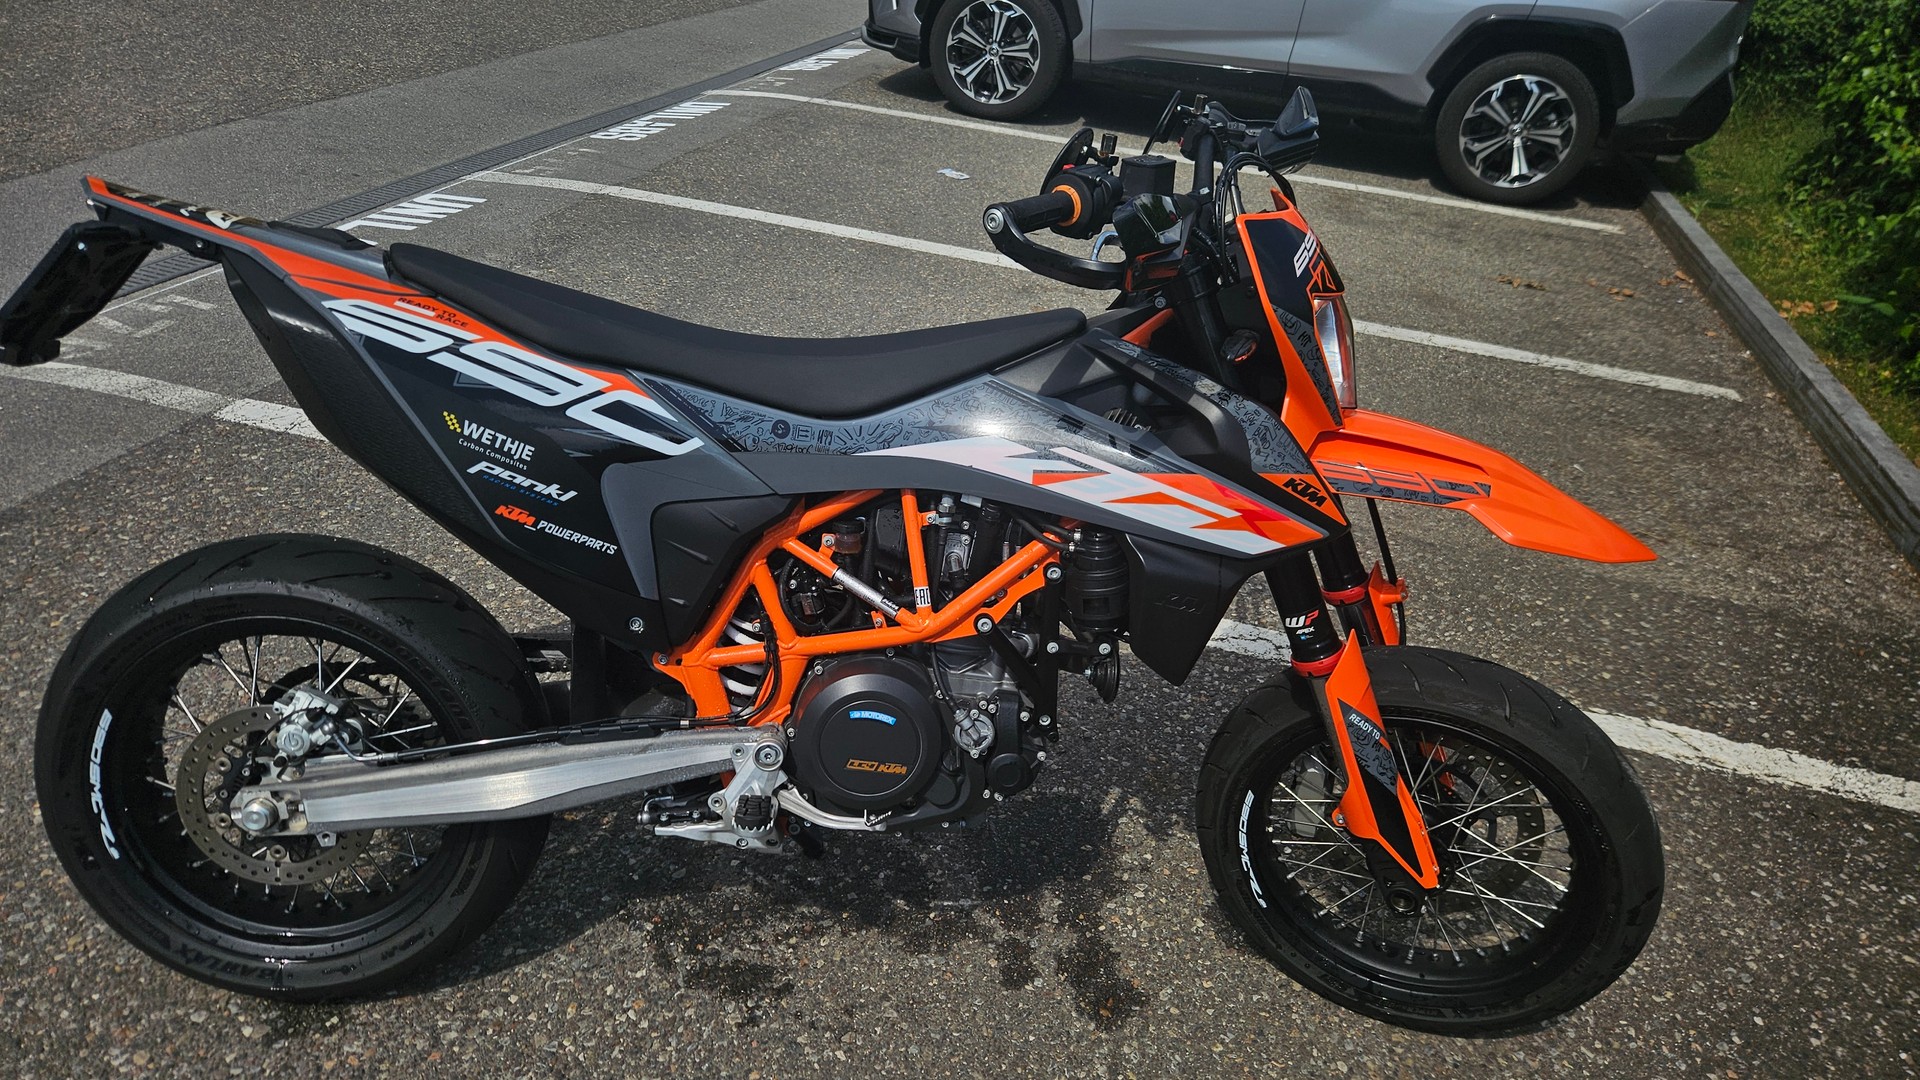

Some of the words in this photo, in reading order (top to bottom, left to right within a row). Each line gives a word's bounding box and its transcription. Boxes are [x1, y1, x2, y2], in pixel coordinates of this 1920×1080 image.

[398, 297, 439, 312] READY
[441, 310, 457, 319] TO
[436, 313, 469, 328] RACE
[462, 419, 535, 462] WETHJE
[458, 438, 484, 454] Carbon
[485, 449, 528, 471] Composites
[482, 474, 517, 491] RACING
[519, 488, 560, 507] SYSTEMS
[1282, 477, 1328, 507] KTM
[1285, 609, 1319, 628] WP
[1348, 713, 1373, 733] READY
[1371, 728, 1381, 740] TO
[877, 762, 908, 775] KTM
